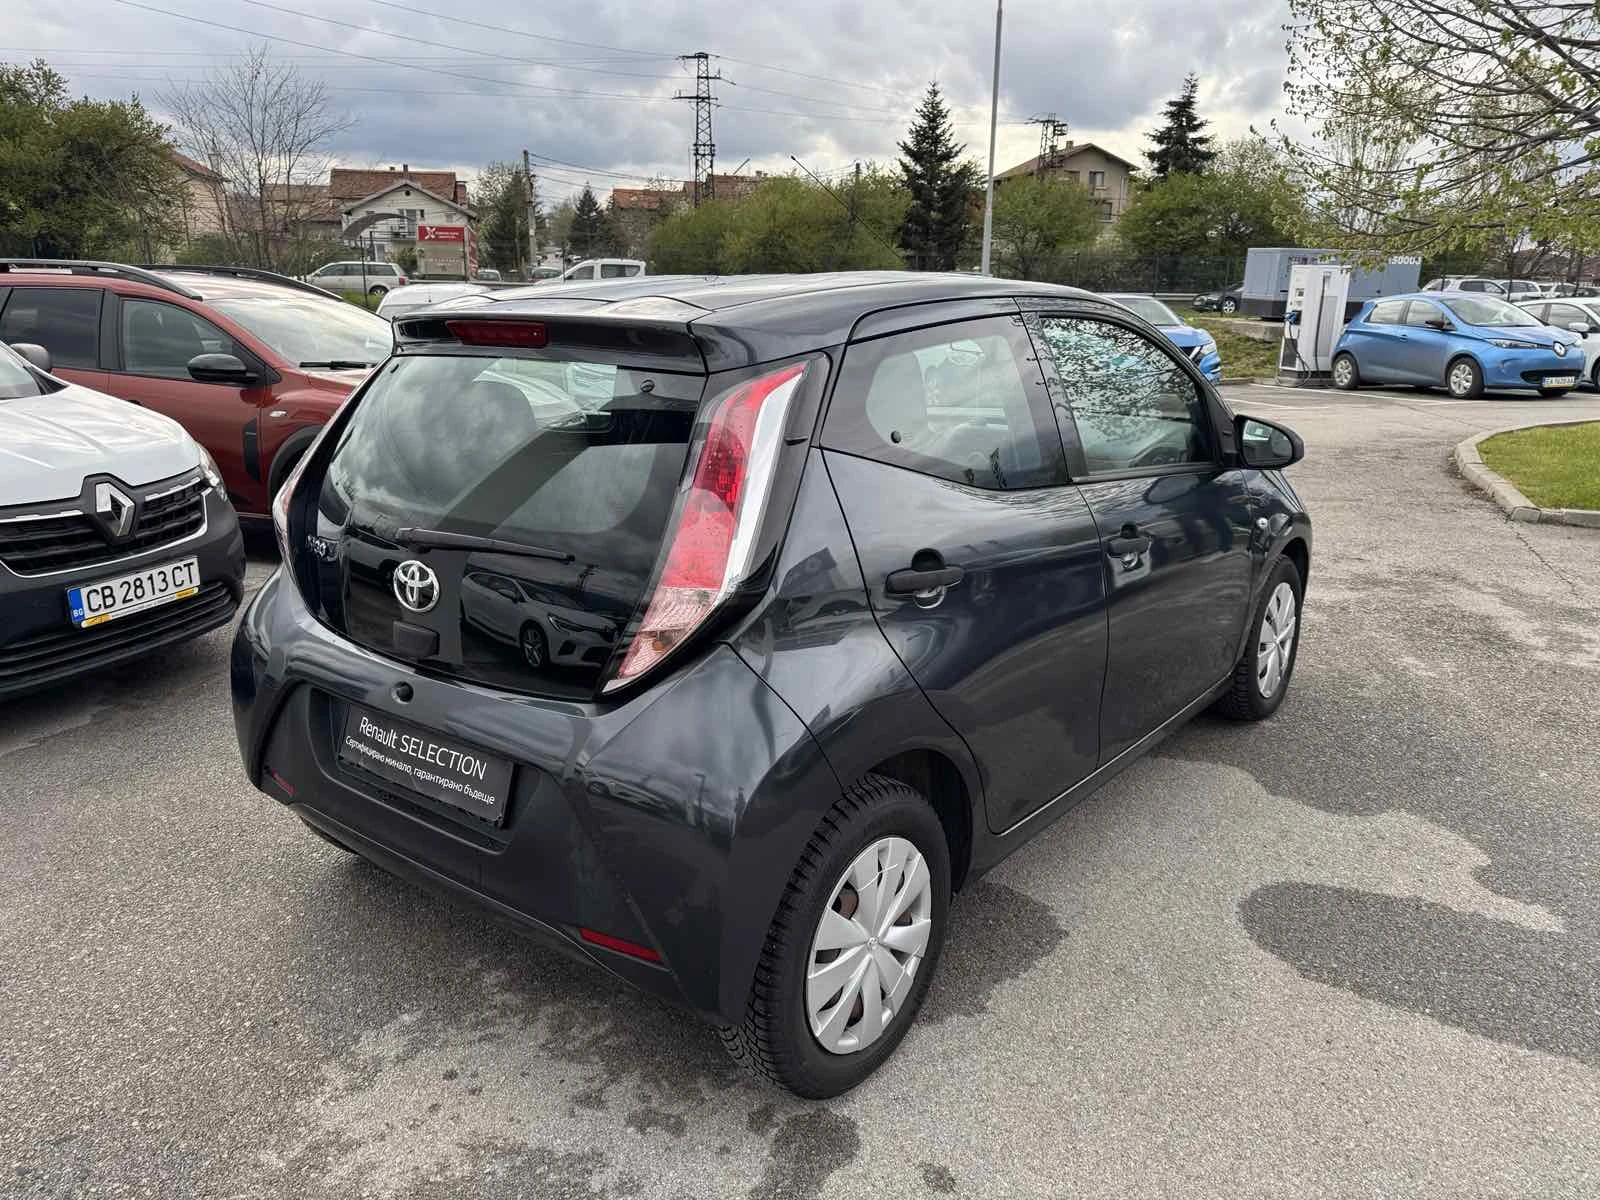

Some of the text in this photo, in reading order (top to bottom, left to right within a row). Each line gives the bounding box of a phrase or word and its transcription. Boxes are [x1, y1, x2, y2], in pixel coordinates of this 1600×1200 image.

[86, 586, 116, 612] CB
[120, 571, 169, 604] 2813
[171, 562, 194, 588] CT
[359, 716, 487, 780] Renault SELECTION
[385, 756, 413, 776] минало,
[413, 767, 463, 791] гарантирано
[463, 784, 496, 805] бъдеще
